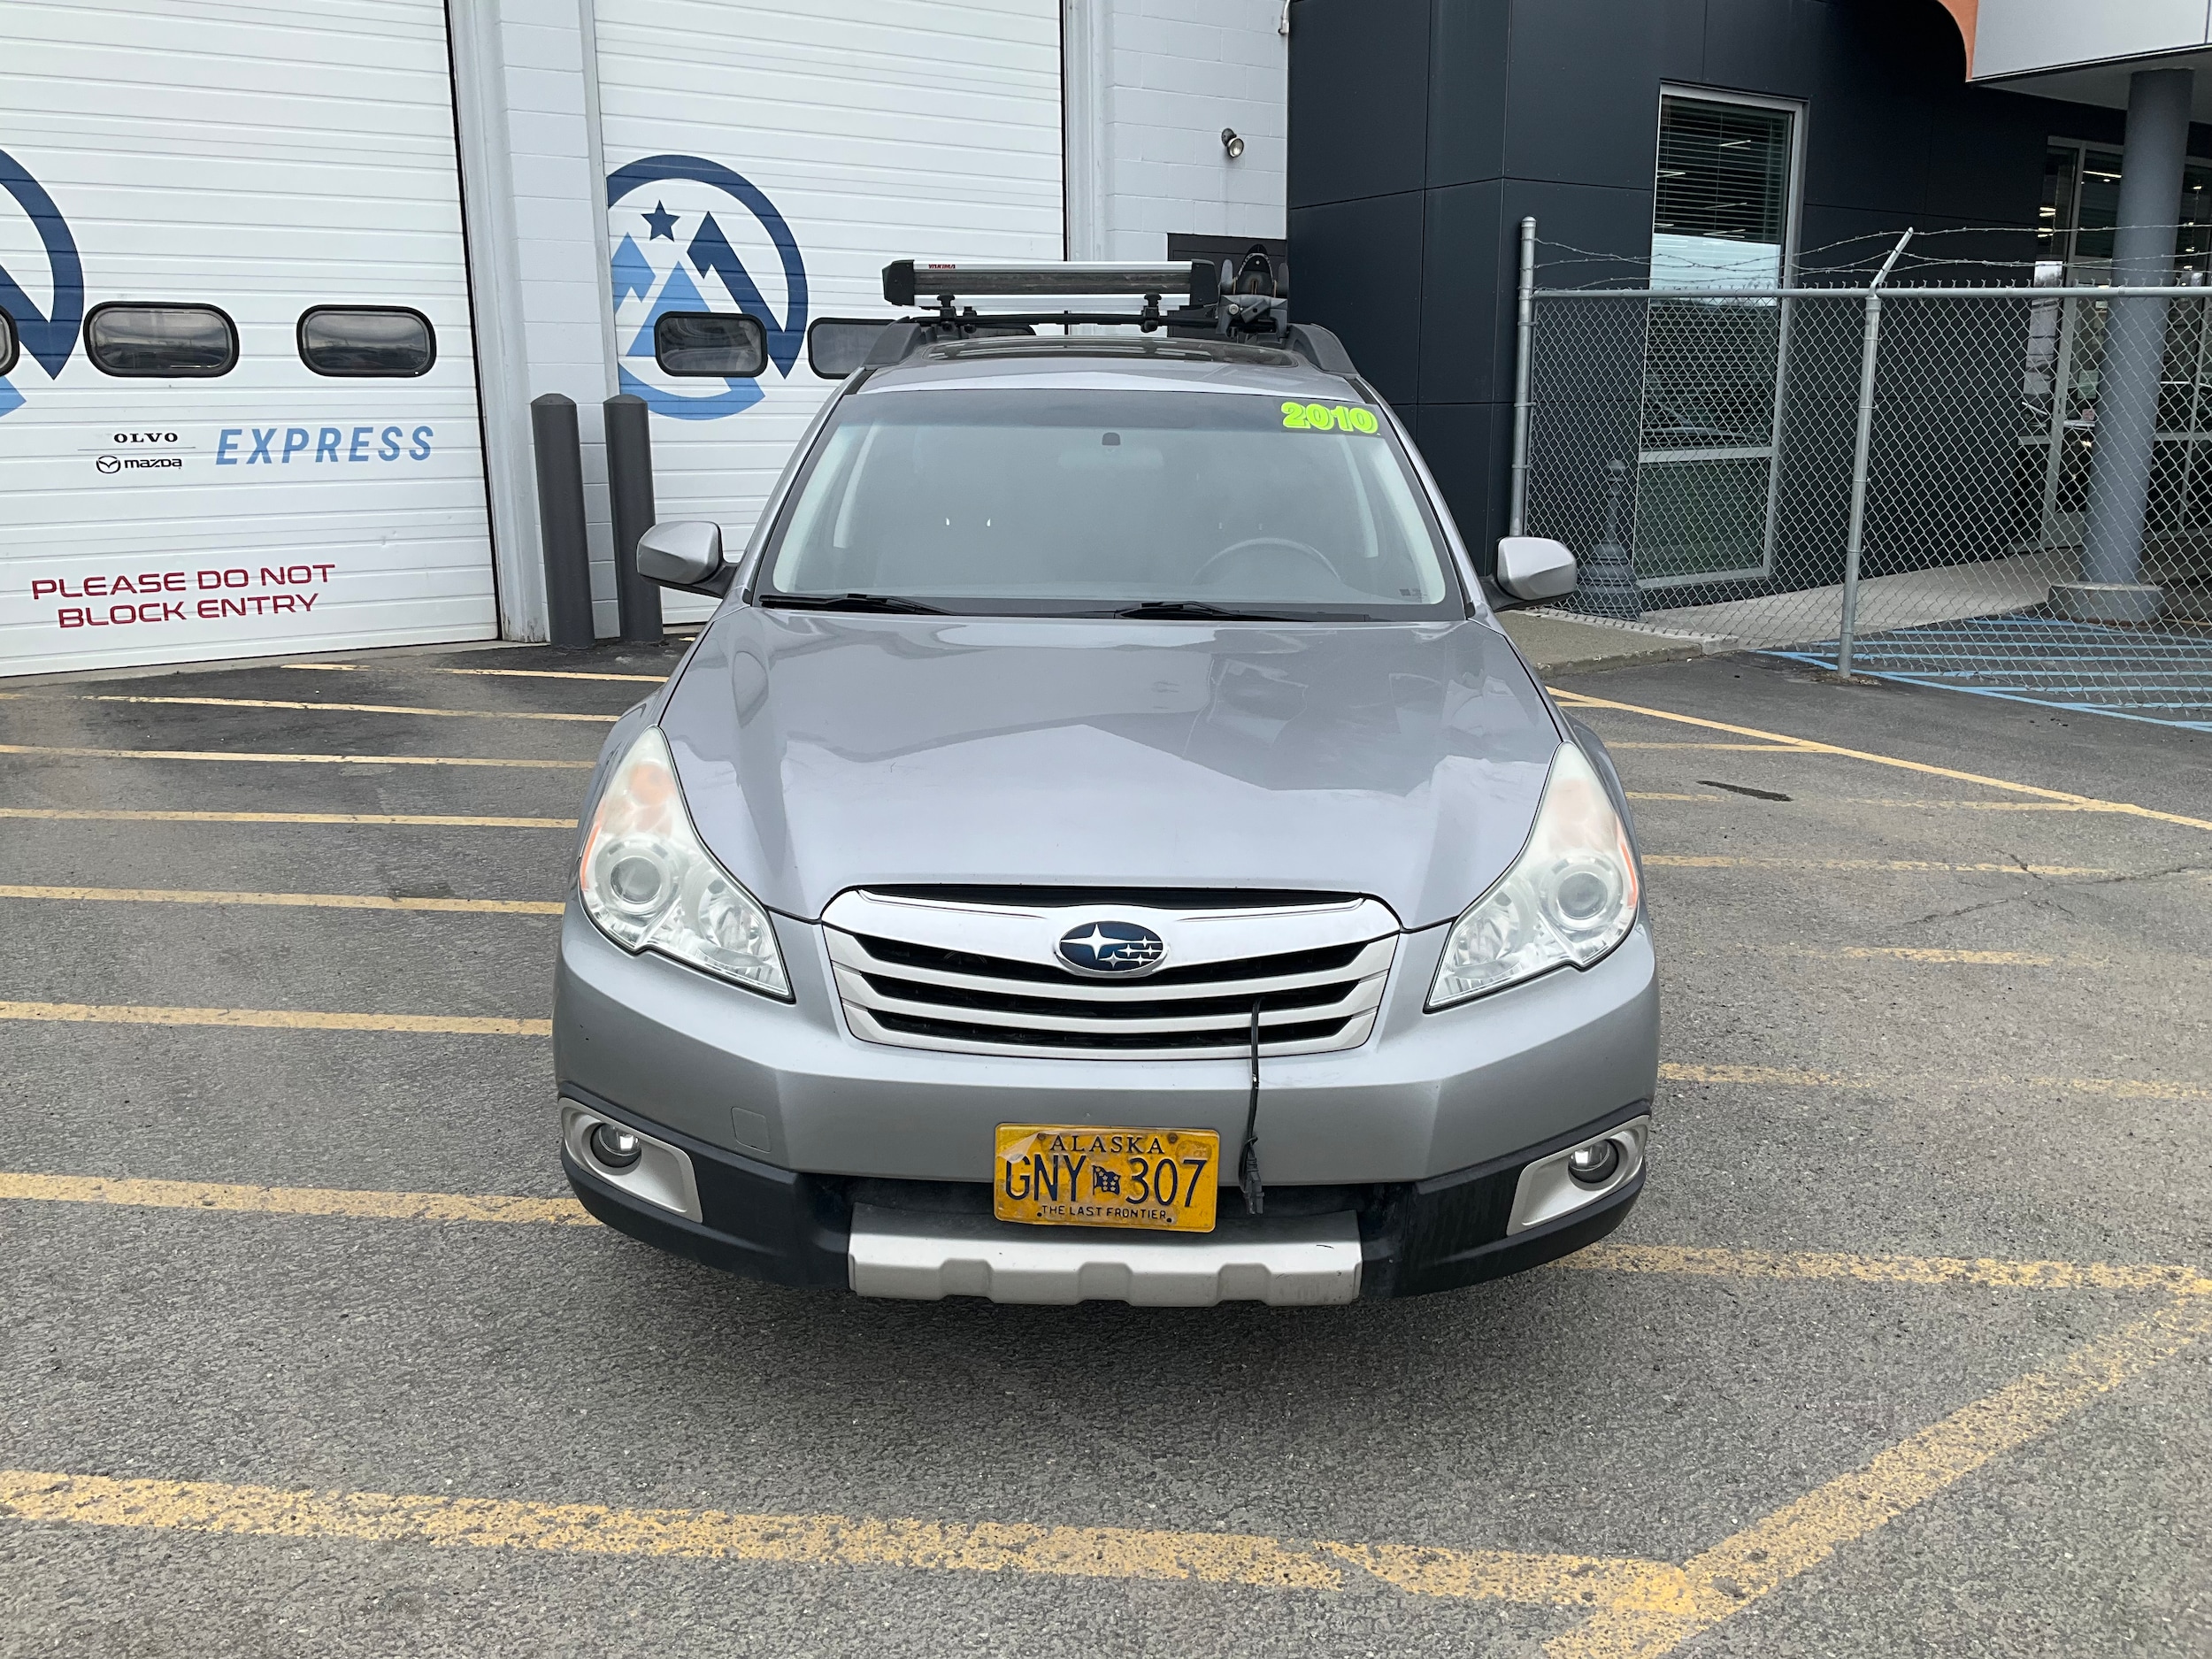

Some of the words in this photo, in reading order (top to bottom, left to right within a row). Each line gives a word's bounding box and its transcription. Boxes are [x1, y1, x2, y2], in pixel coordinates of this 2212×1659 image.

[1281, 402, 1379, 434] 2010
[215, 426, 434, 465] EXPRESS
[32, 572, 187, 600] PLEASE
[196, 569, 250, 590] DO
[260, 564, 336, 587] NOT
[58, 601, 188, 628] BLOCK
[196, 593, 319, 619] ENTRY
[1049, 1134, 1165, 1155] ALASKA
[1005, 1153, 1087, 1202] GNY
[1125, 1157, 1208, 1208] 307
[1041, 1205, 1066, 1216] THE
[1069, 1206, 1102, 1217] LAST
[1106, 1207, 1167, 1220] FRONTIER
